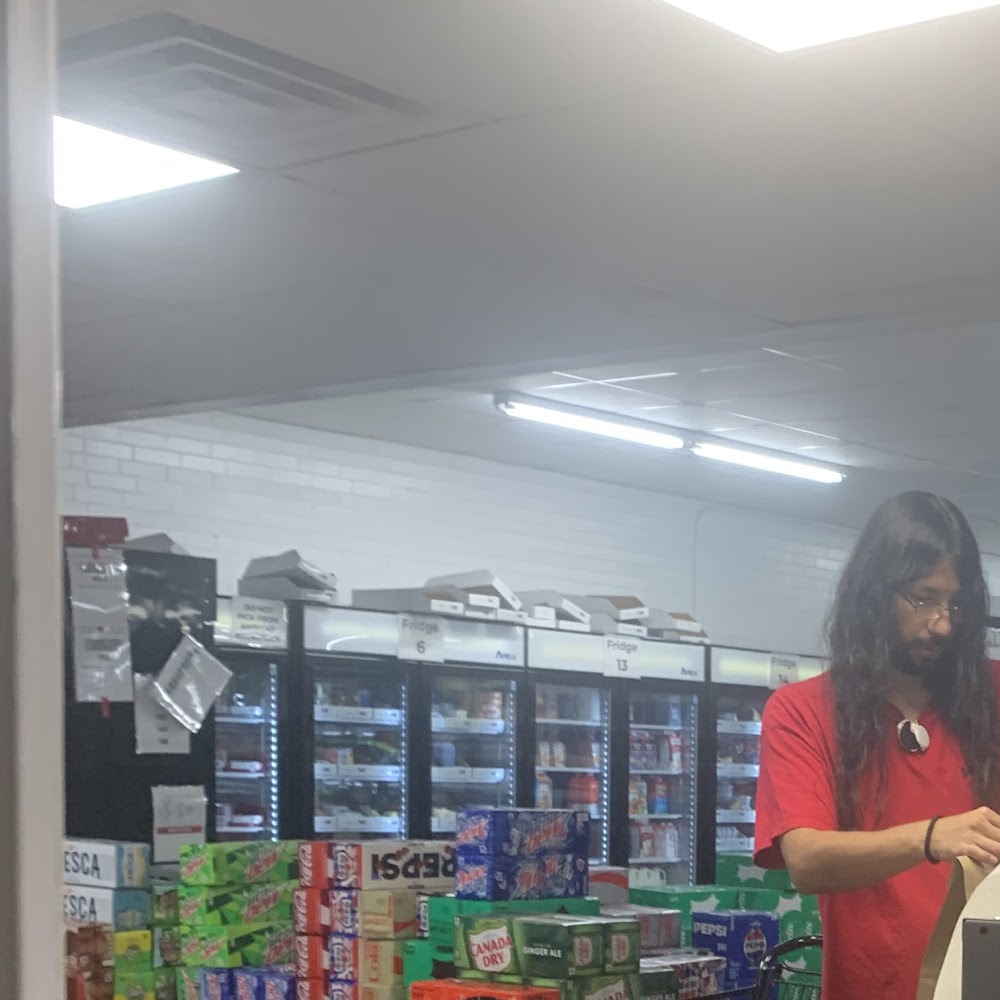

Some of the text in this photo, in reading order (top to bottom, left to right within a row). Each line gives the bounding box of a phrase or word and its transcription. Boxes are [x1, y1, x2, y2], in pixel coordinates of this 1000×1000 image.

[402, 619, 439, 634] Fridge
[416, 640, 426, 654] 6
[607, 639, 638, 654] Fridge
[616, 659, 628, 672] 13
[771, 656, 797, 670] Fridge
[693, 921, 727, 937] PEPSI
[470, 935, 512, 958] CANADA
[523, 946, 562, 958] GINGER ALE
[483, 952, 505, 968] DRY
